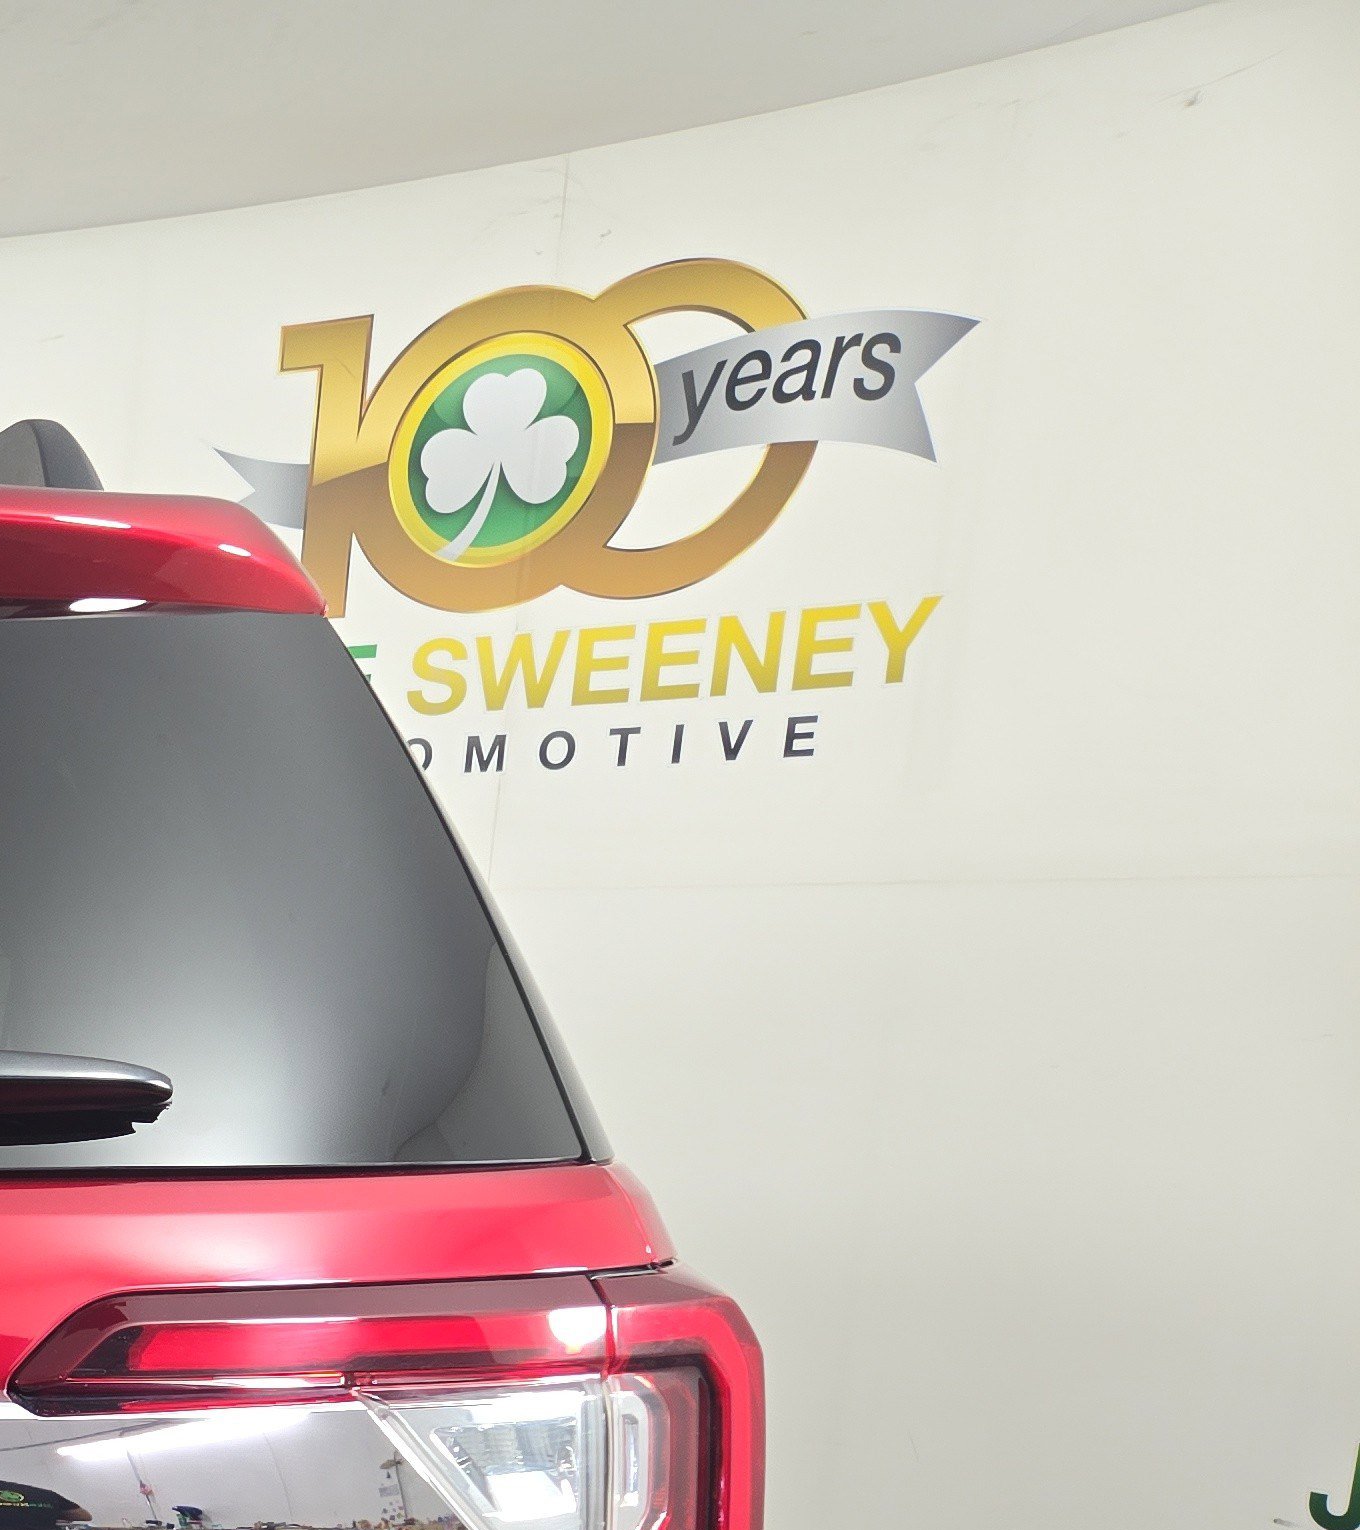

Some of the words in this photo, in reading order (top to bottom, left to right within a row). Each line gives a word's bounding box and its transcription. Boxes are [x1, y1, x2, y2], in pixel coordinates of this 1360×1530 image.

[280, 257, 818, 619] 100
[671, 331, 902, 446] years
[407, 595, 942, 716] SWEENEY
